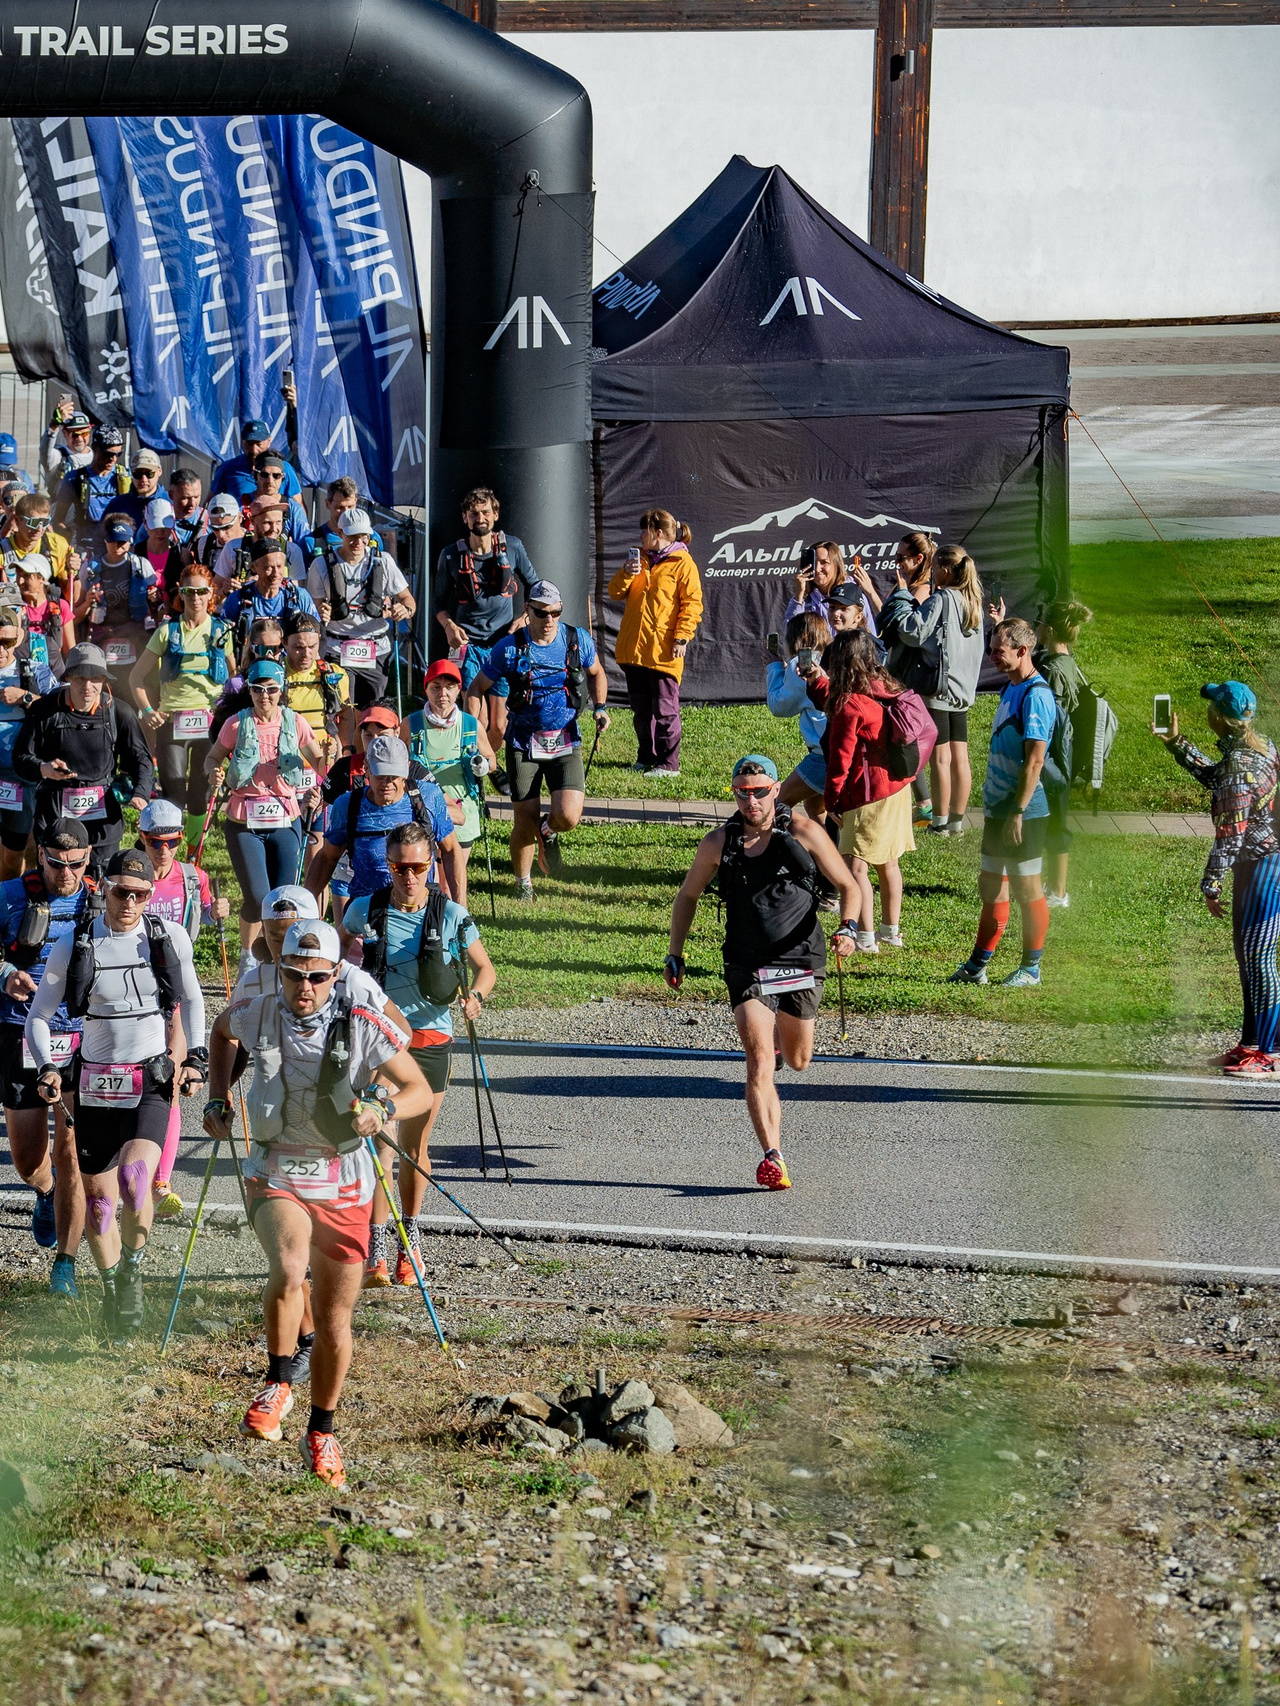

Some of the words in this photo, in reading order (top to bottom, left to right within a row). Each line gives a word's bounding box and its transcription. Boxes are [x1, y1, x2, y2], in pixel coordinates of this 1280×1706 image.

[14, 25, 135, 56] TRAIL
[145, 24, 289, 56] SERIES
[704, 567, 756, 578] Эксперт
[767, 566, 797, 577] горн
[109, 645, 126, 654] 276
[349, 647, 368, 656] 209
[184, 717, 202, 727] 271
[542, 737, 560, 748] 256
[301, 775, 312, 786] 18
[72, 796, 94, 808] 228
[258, 804, 280, 815] 247
[96, 1077, 124, 1090] 217
[285, 1160, 319, 1176] 252
